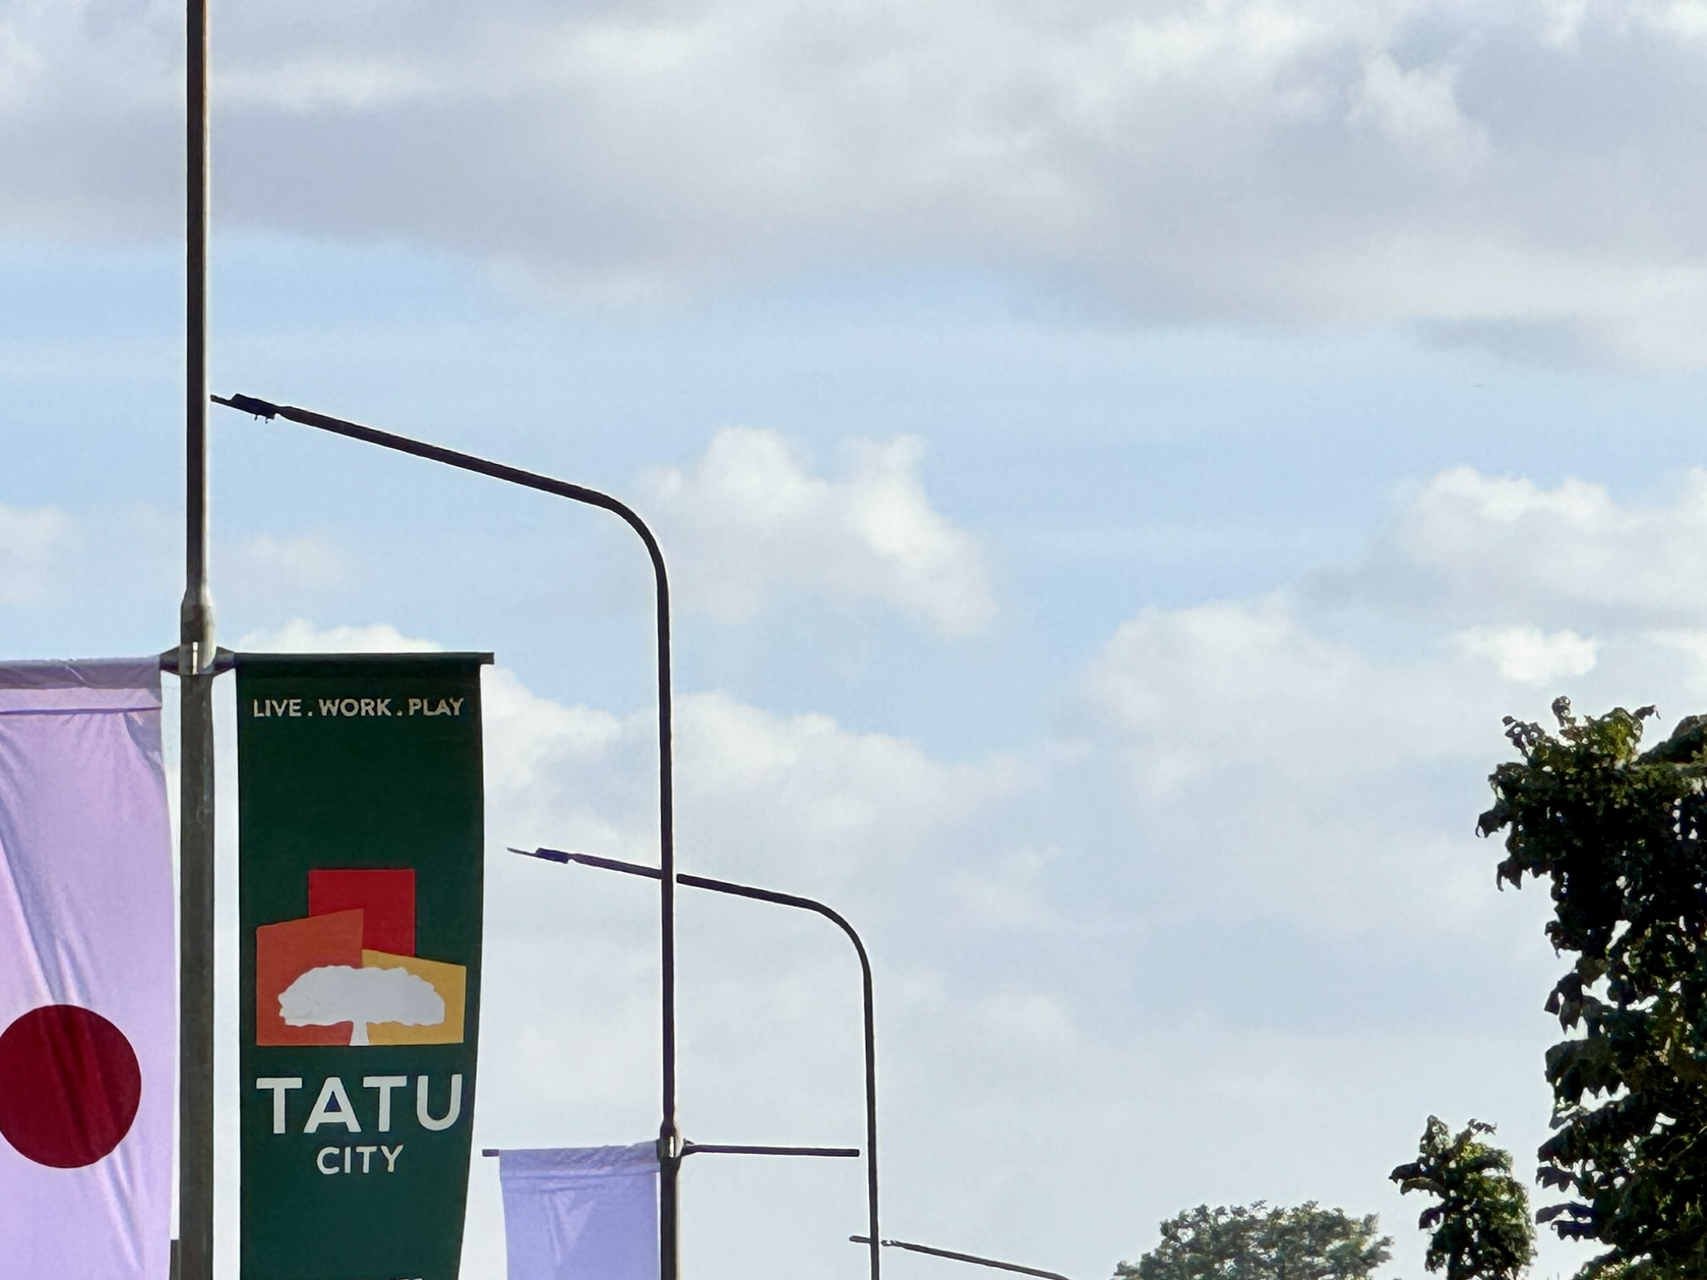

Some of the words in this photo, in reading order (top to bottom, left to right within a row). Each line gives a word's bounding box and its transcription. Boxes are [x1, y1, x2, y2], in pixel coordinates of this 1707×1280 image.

[253, 698, 302, 718] LIVE
[318, 698, 392, 717] WORK
[407, 697, 464, 716] PLAY
[255, 1073, 464, 1136] TATU
[316, 1144, 404, 1176] CITY
